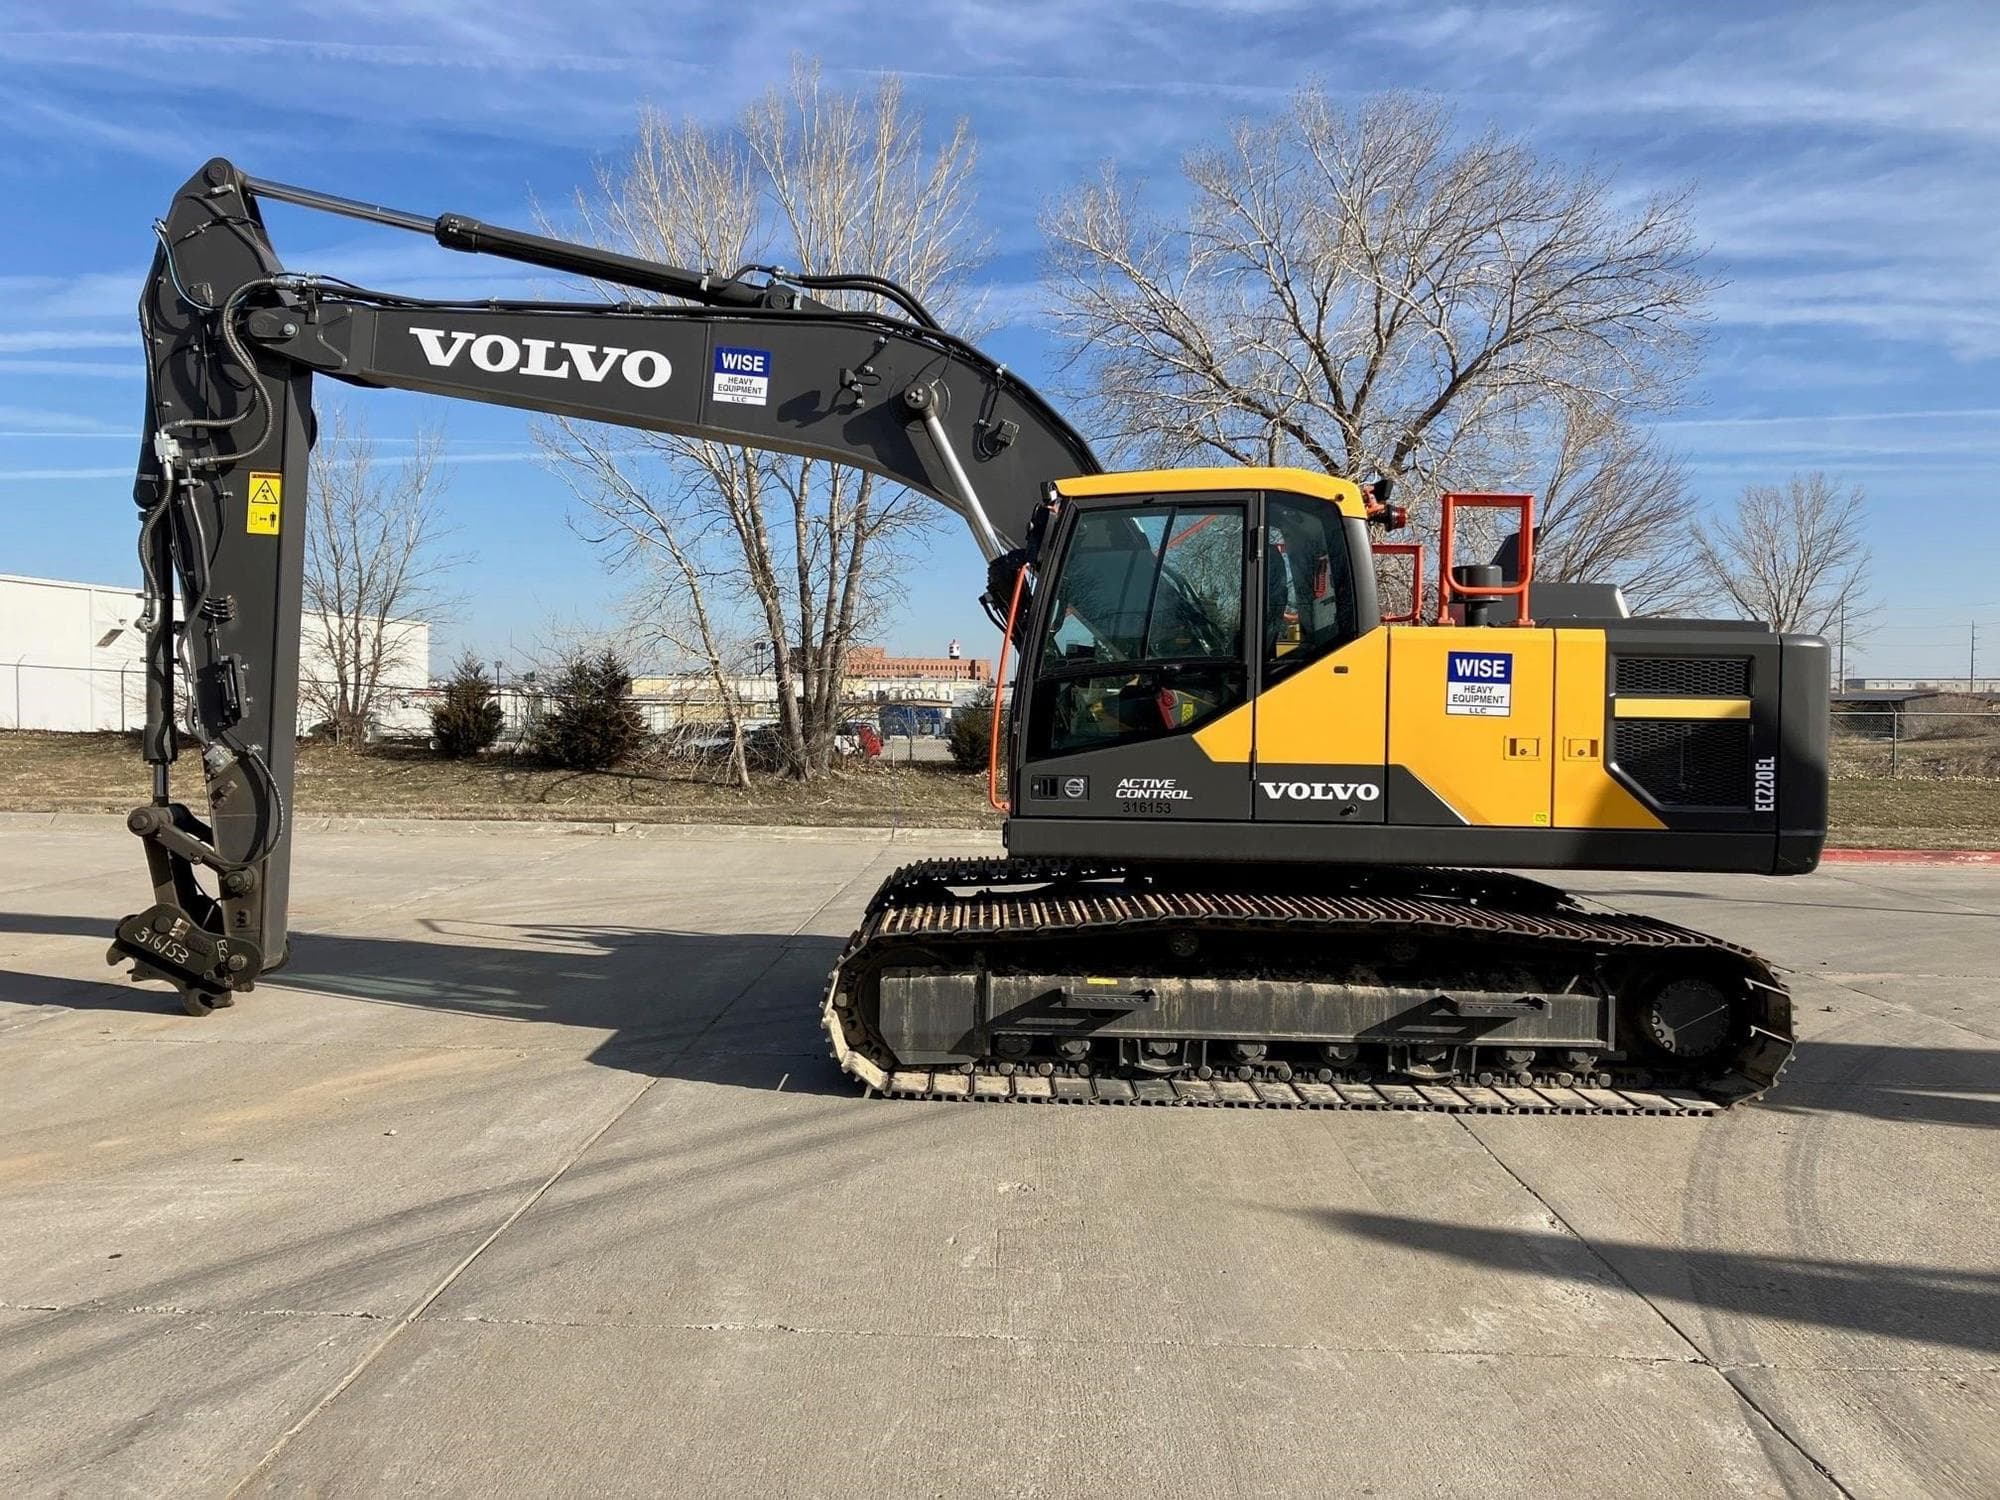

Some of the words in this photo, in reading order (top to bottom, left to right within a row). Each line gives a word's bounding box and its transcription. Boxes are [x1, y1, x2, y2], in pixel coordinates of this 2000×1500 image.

[409, 327, 672, 388] VOLVO
[722, 352, 764, 372] WISE
[728, 377, 754, 385] HEAVY
[718, 384, 763, 394] EQUIPMENT
[1455, 658, 1505, 678] WISE
[1464, 685, 1494, 694] HEAVY
[1452, 694, 1504, 704] EQUIPMENT
[1118, 778, 1176, 789] ACTIVE
[1755, 756, 1775, 811] EC220EL
[1115, 789, 1193, 800] CONTROL
[1259, 782, 1380, 801] VOLVO
[1123, 801, 1172, 814] 316153
[134, 927, 189, 964] 316153
